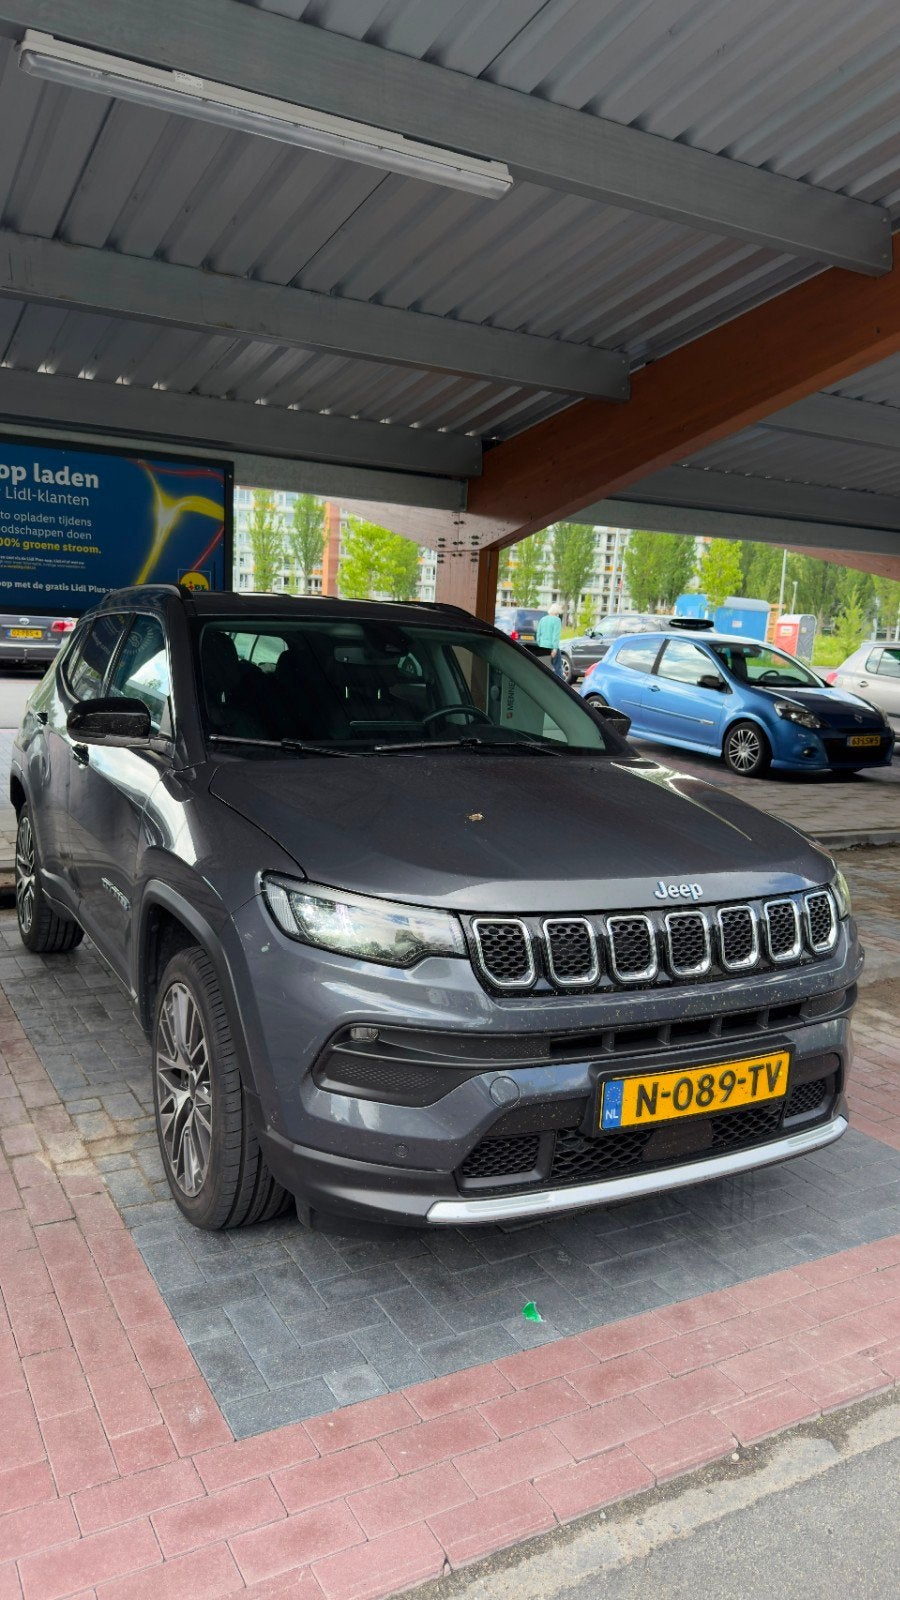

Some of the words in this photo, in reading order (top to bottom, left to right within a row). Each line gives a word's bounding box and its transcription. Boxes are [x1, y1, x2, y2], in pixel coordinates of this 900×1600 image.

[0, 464, 26, 486] op
[34, 463, 99, 488] laden
[5, 486, 89, 507] Lidl-klanten
[14, 512, 55, 524] opladen
[58, 515, 92, 527] tijdens
[1, 524, 64, 539] odschappen
[67, 529, 92, 540] doen
[23, 540, 60, 551] groene
[62, 543, 102, 554] stroom.
[15, 581, 31, 589] met
[33, 581, 44, 589] de
[45, 582, 70, 592] gratis
[71, 584, 87, 592] Lidl
[653, 880, 704, 901] Jeep
[605, 1109, 619, 1120] NL
[635, 1060, 783, 1118] N-089-TV
